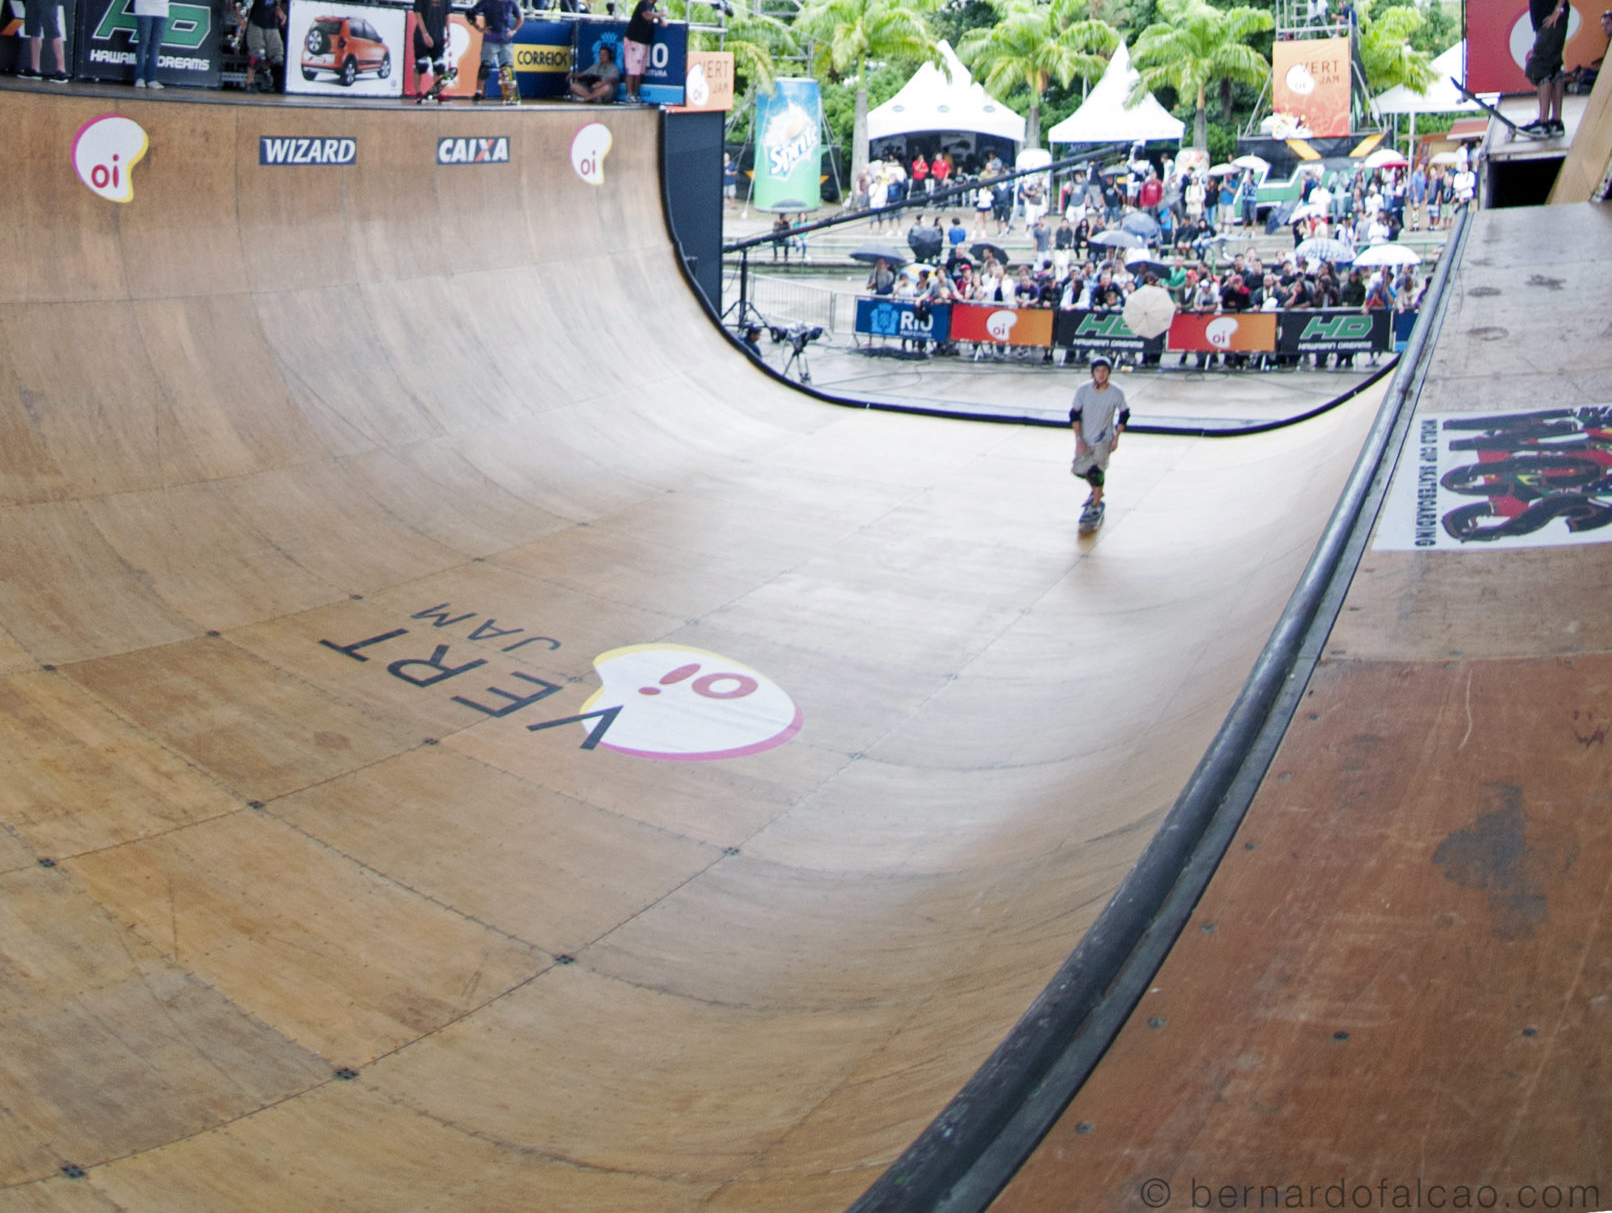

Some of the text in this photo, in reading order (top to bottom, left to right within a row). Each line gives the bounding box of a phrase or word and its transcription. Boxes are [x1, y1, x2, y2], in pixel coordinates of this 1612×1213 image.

[157, 55, 211, 71] DREAMS
[517, 50, 568, 67] CORREIOS
[261, 138, 356, 163] WIZARD
[438, 138, 509, 163] CAIXA
[580, 150, 596, 175] oi
[91, 152, 119, 188] oi
[993, 323, 1005, 336] oi
[1213, 330, 1226, 344] oi
[1300, 315, 1373, 339] HD
[1414, 465, 1438, 547] SKATEBOARDING
[410, 602, 562, 653] JAM
[319, 627, 624, 750] VERT
